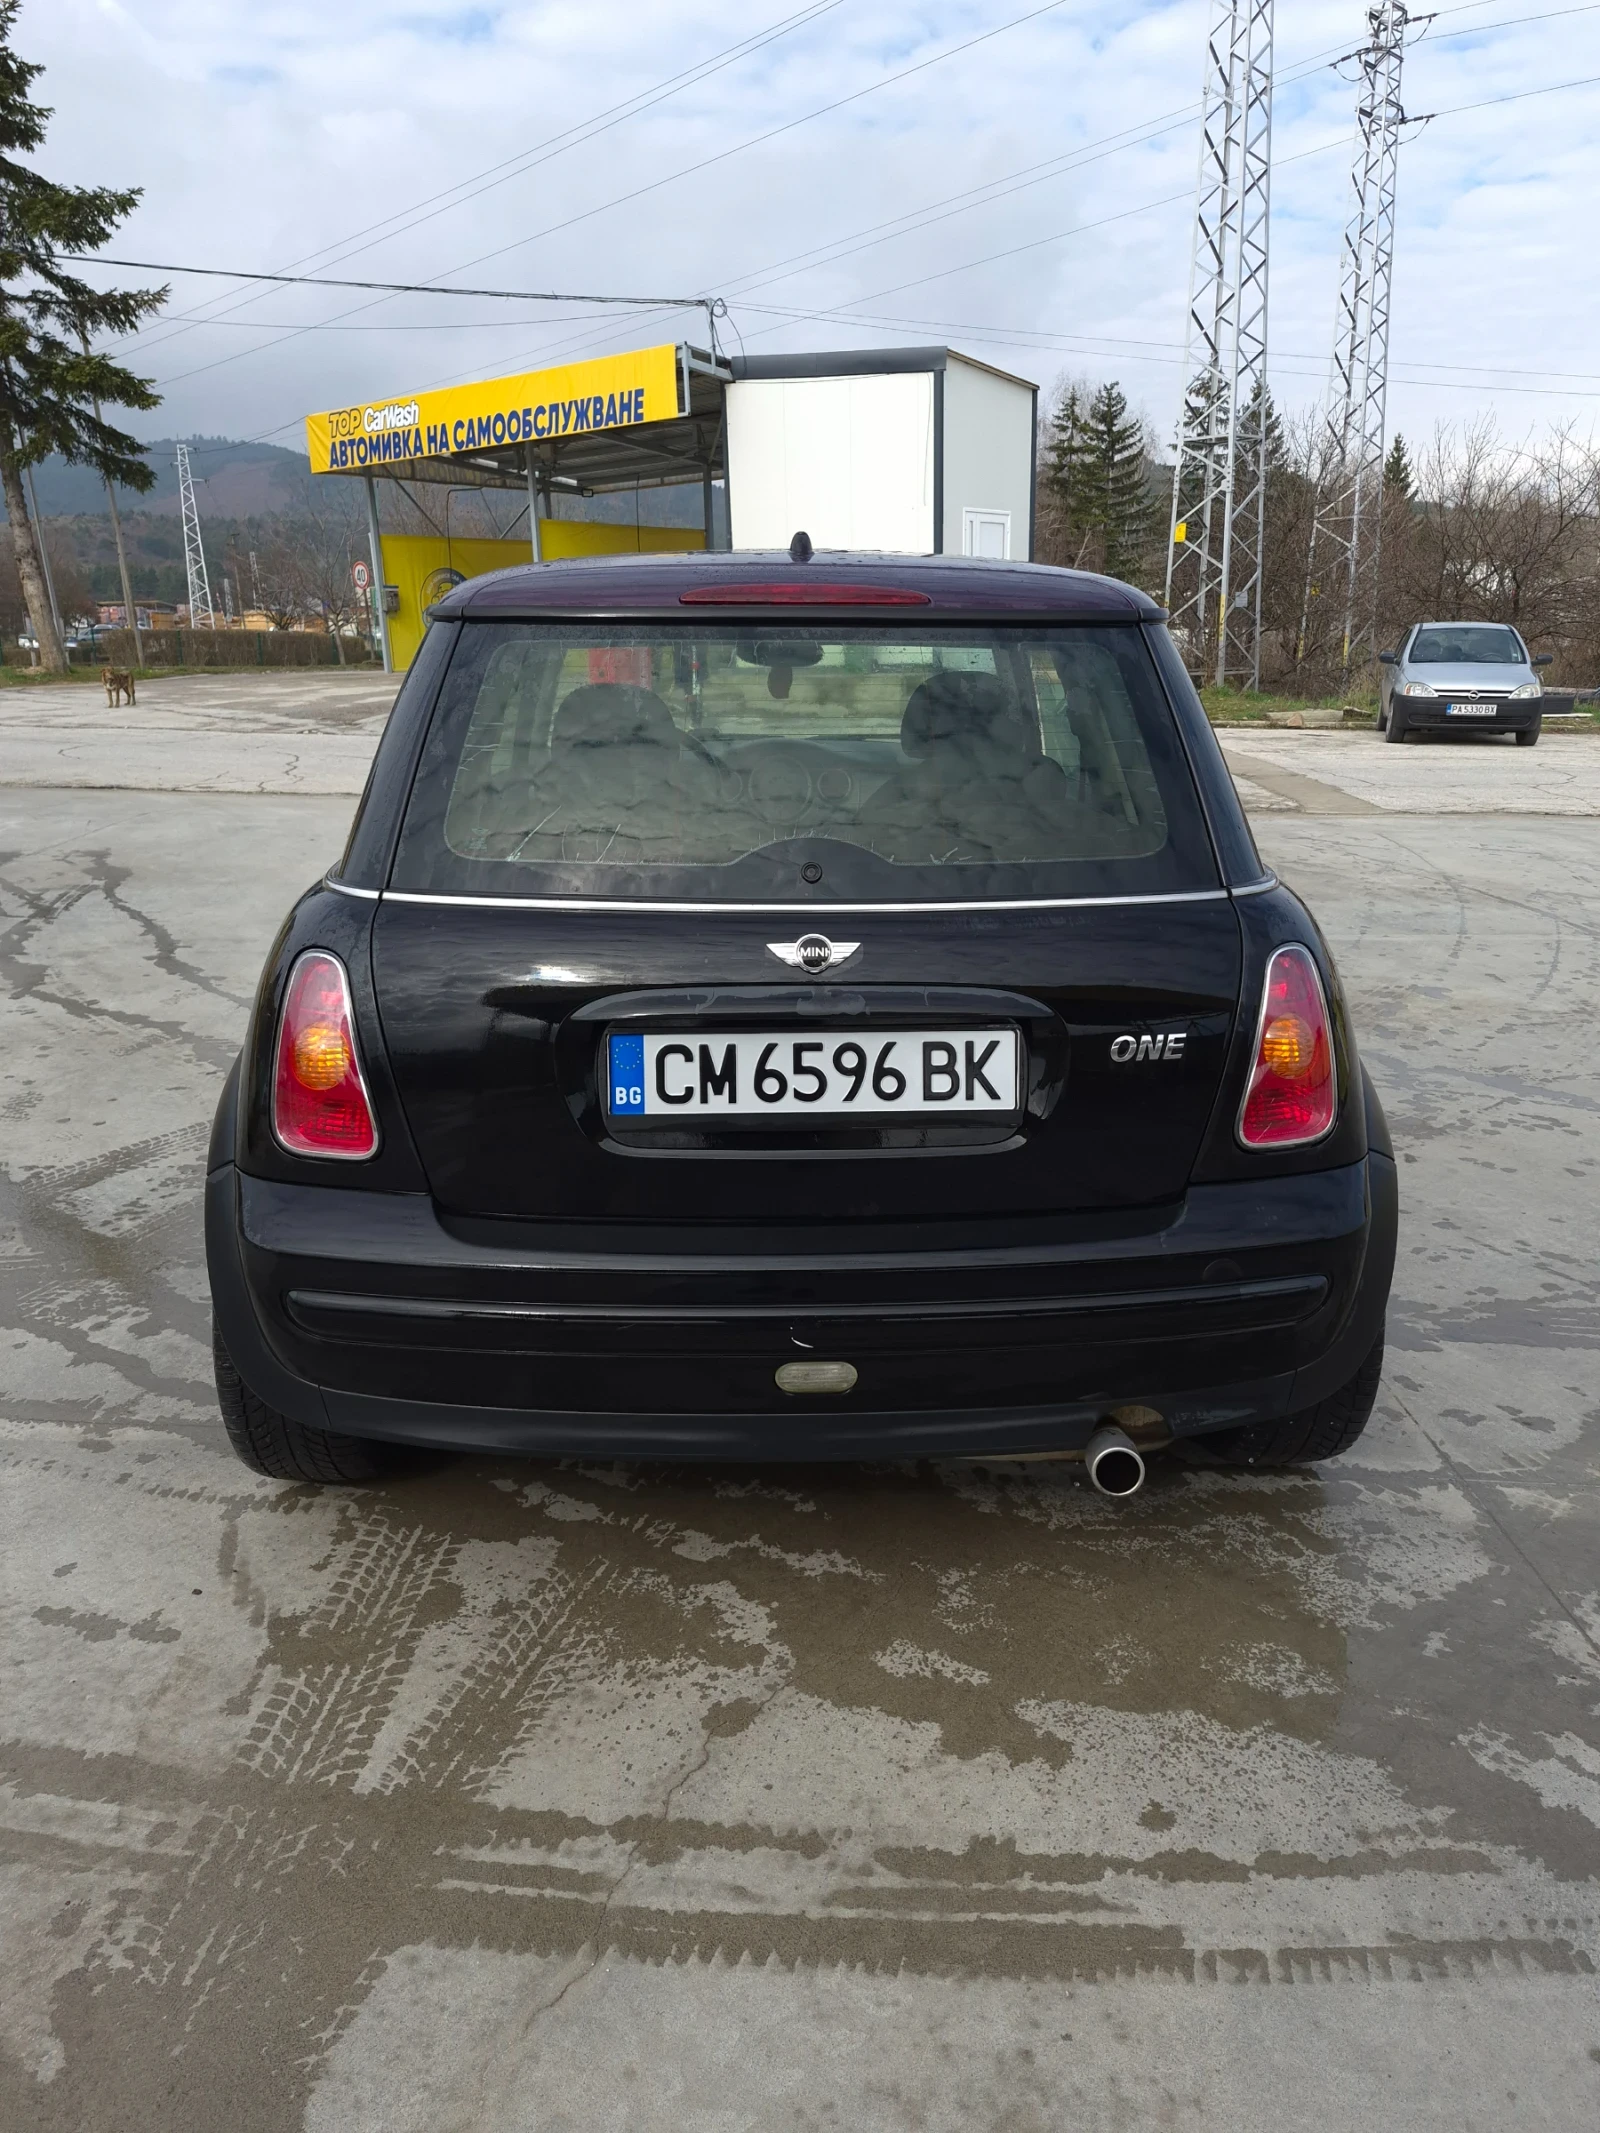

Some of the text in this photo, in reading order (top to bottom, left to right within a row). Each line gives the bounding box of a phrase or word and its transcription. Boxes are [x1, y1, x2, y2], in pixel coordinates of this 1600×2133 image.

[329, 400, 420, 438] TOP CarWash
[329, 388, 645, 469] АВТОМИВКА НА САМООБСЛУЖВАНЕ
[356, 568, 366, 582] 40
[1451, 705, 1463, 714] PA
[1463, 705, 1484, 714] 5330
[800, 946, 830, 957] MINI
[1110, 1033, 1187, 1063] ONE
[655, 1040, 1001, 1104] CM 6596 BK
[615, 1086, 642, 1105] BG
